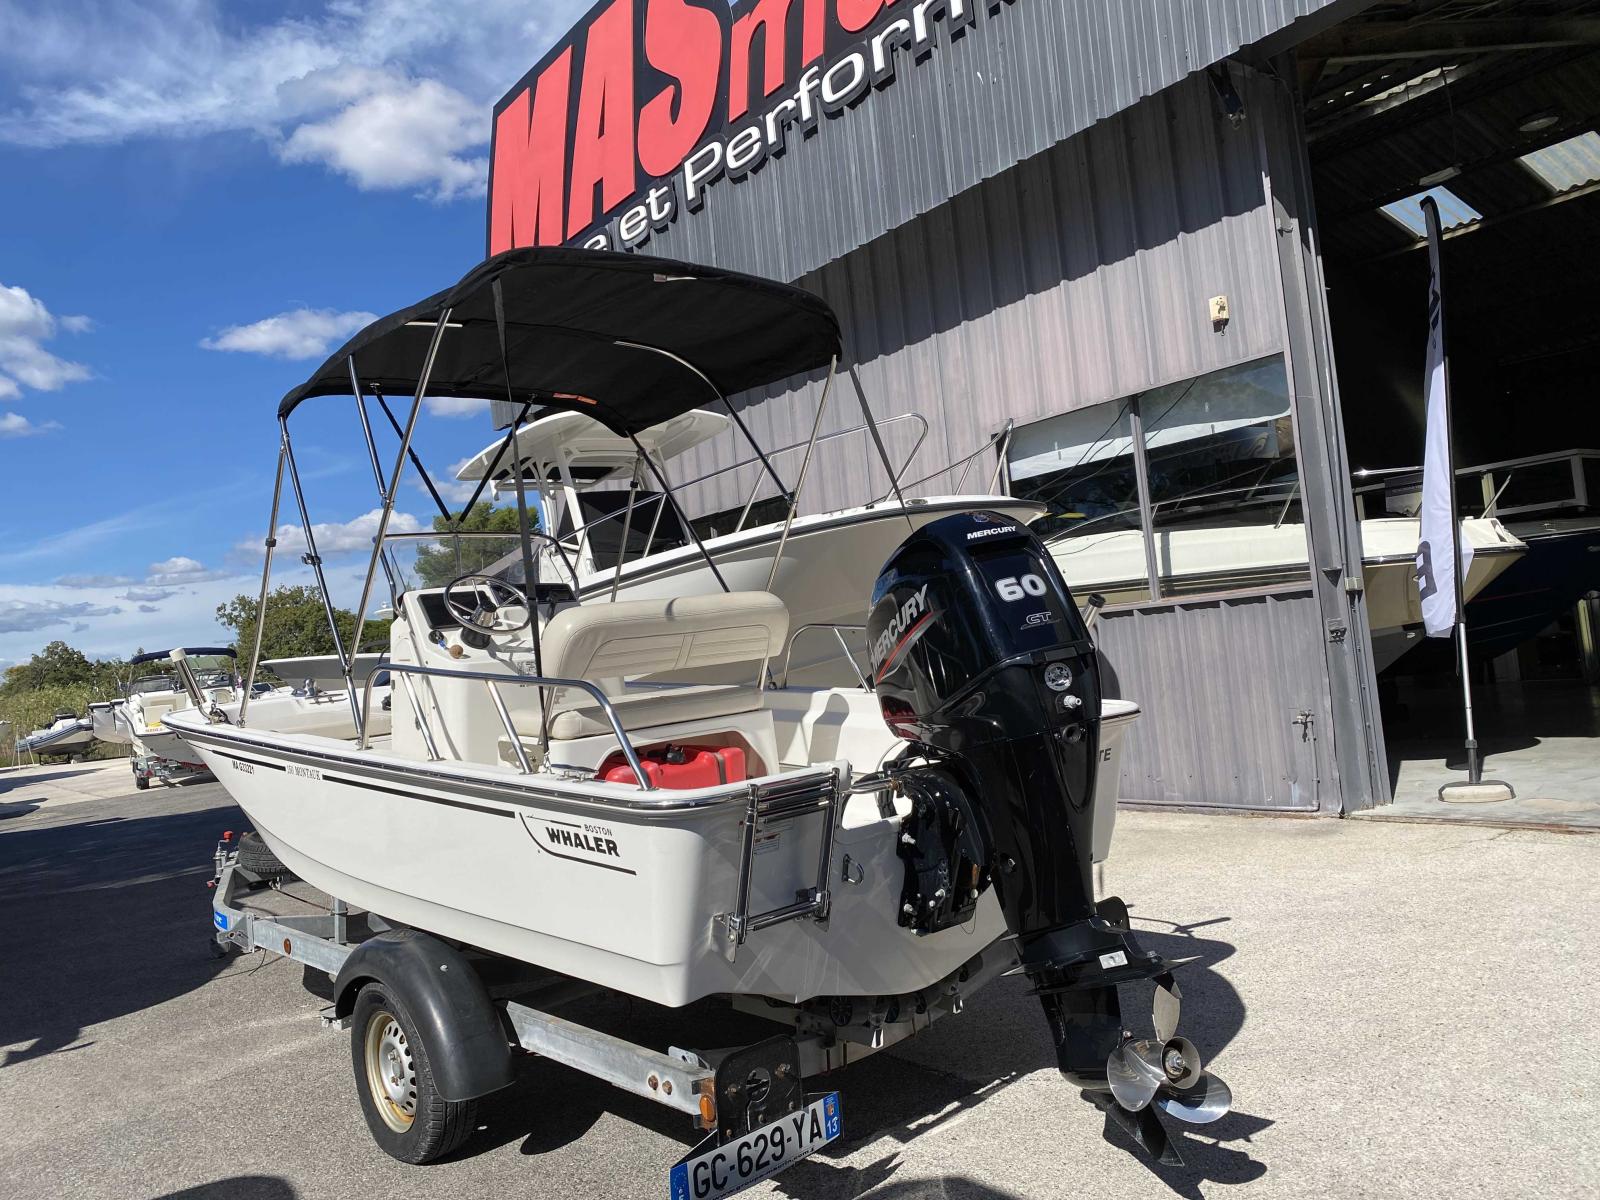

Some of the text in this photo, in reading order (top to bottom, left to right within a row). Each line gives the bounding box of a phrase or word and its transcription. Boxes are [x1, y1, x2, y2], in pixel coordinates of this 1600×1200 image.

[490, 0, 906, 258] MASm
[619, 186, 672, 242] et
[967, 525, 1017, 540] MERCURY
[994, 573, 1047, 603] 60
[870, 583, 928, 673] MERCURY
[545, 826, 620, 858] WHALER
[584, 824, 613, 837] BOSTON
[826, 1116, 839, 1135] 13
[692, 1108, 823, 1199] GC-629-YA
